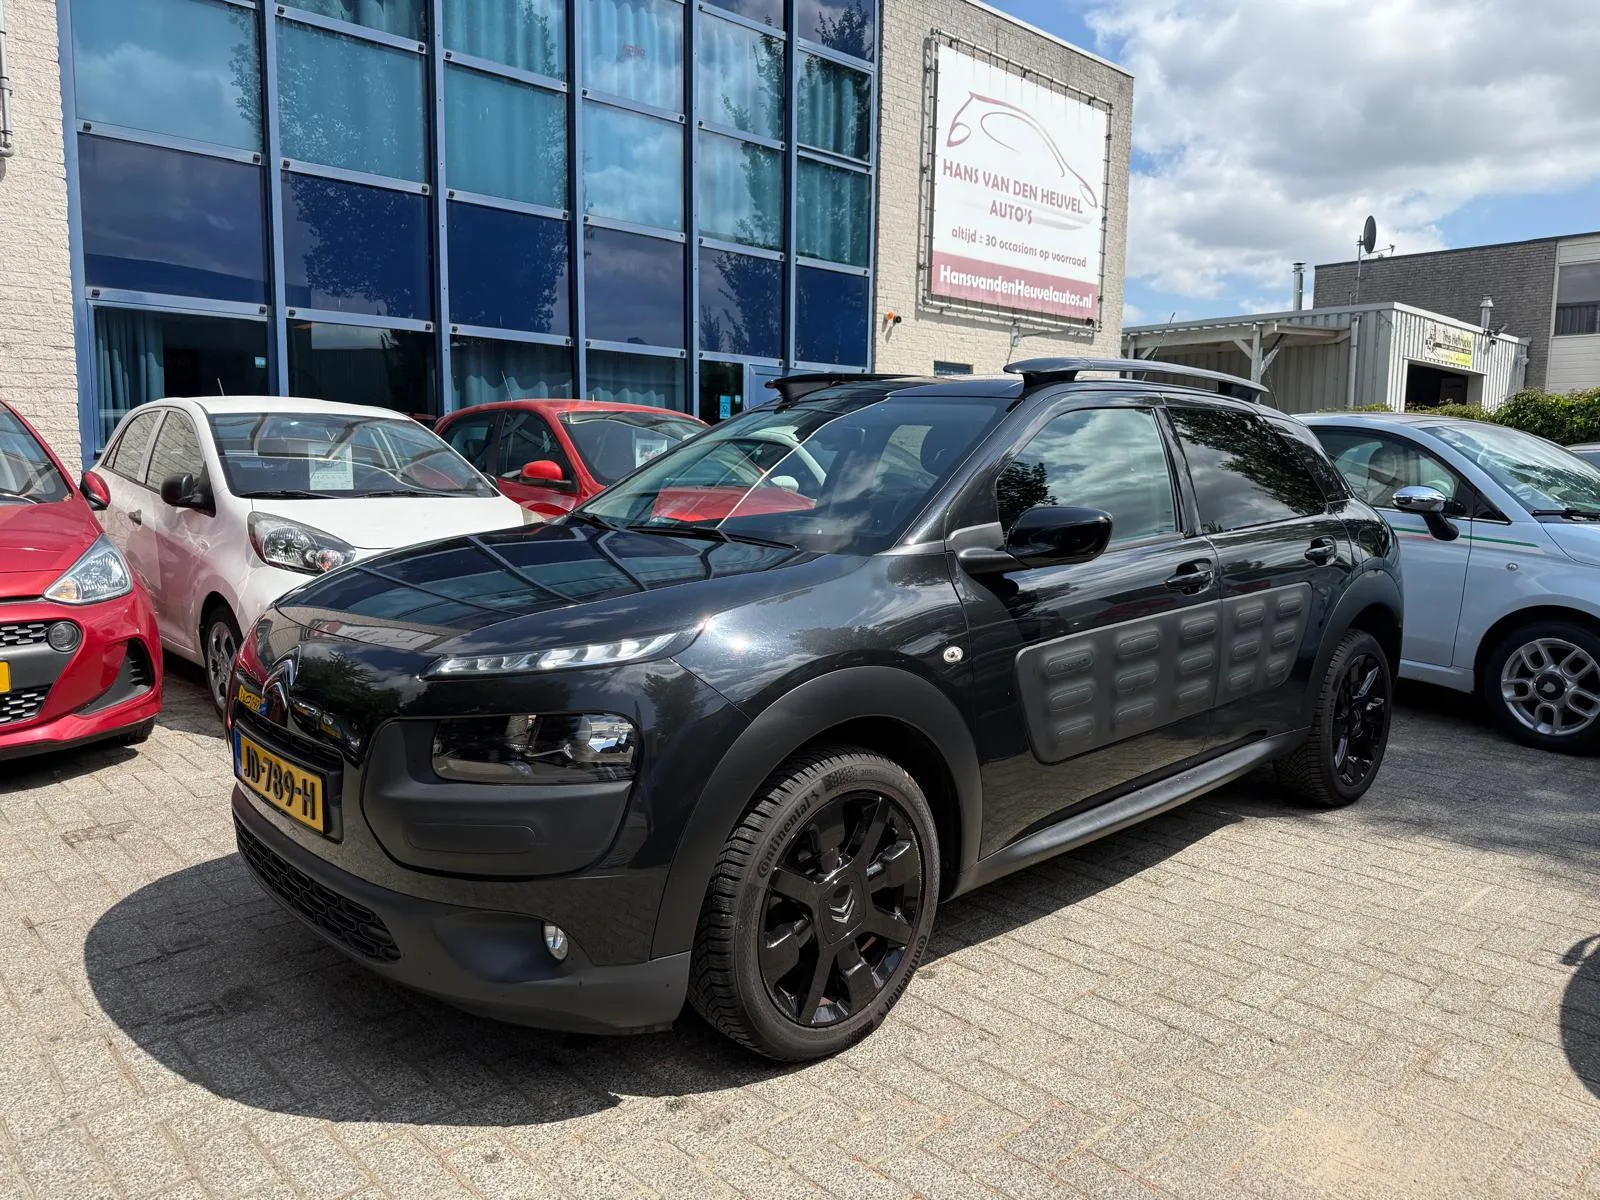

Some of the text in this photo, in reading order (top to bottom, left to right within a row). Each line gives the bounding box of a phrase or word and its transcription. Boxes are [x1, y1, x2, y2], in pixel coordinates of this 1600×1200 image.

[943, 158, 1084, 214] HANS VAN DEN HEUVEL
[989, 199, 1033, 225] AUTO'S
[951, 226, 977, 244] altijd
[985, 234, 997, 248] 30
[999, 239, 1037, 257] occasions
[1039, 249, 1050, 261] op
[1051, 253, 1087, 268] voorraad
[939, 264, 1093, 309] HansvandenHeuvelautos.nl
[243, 745, 316, 821] JD-789-H
[757, 797, 811, 879] Continental
